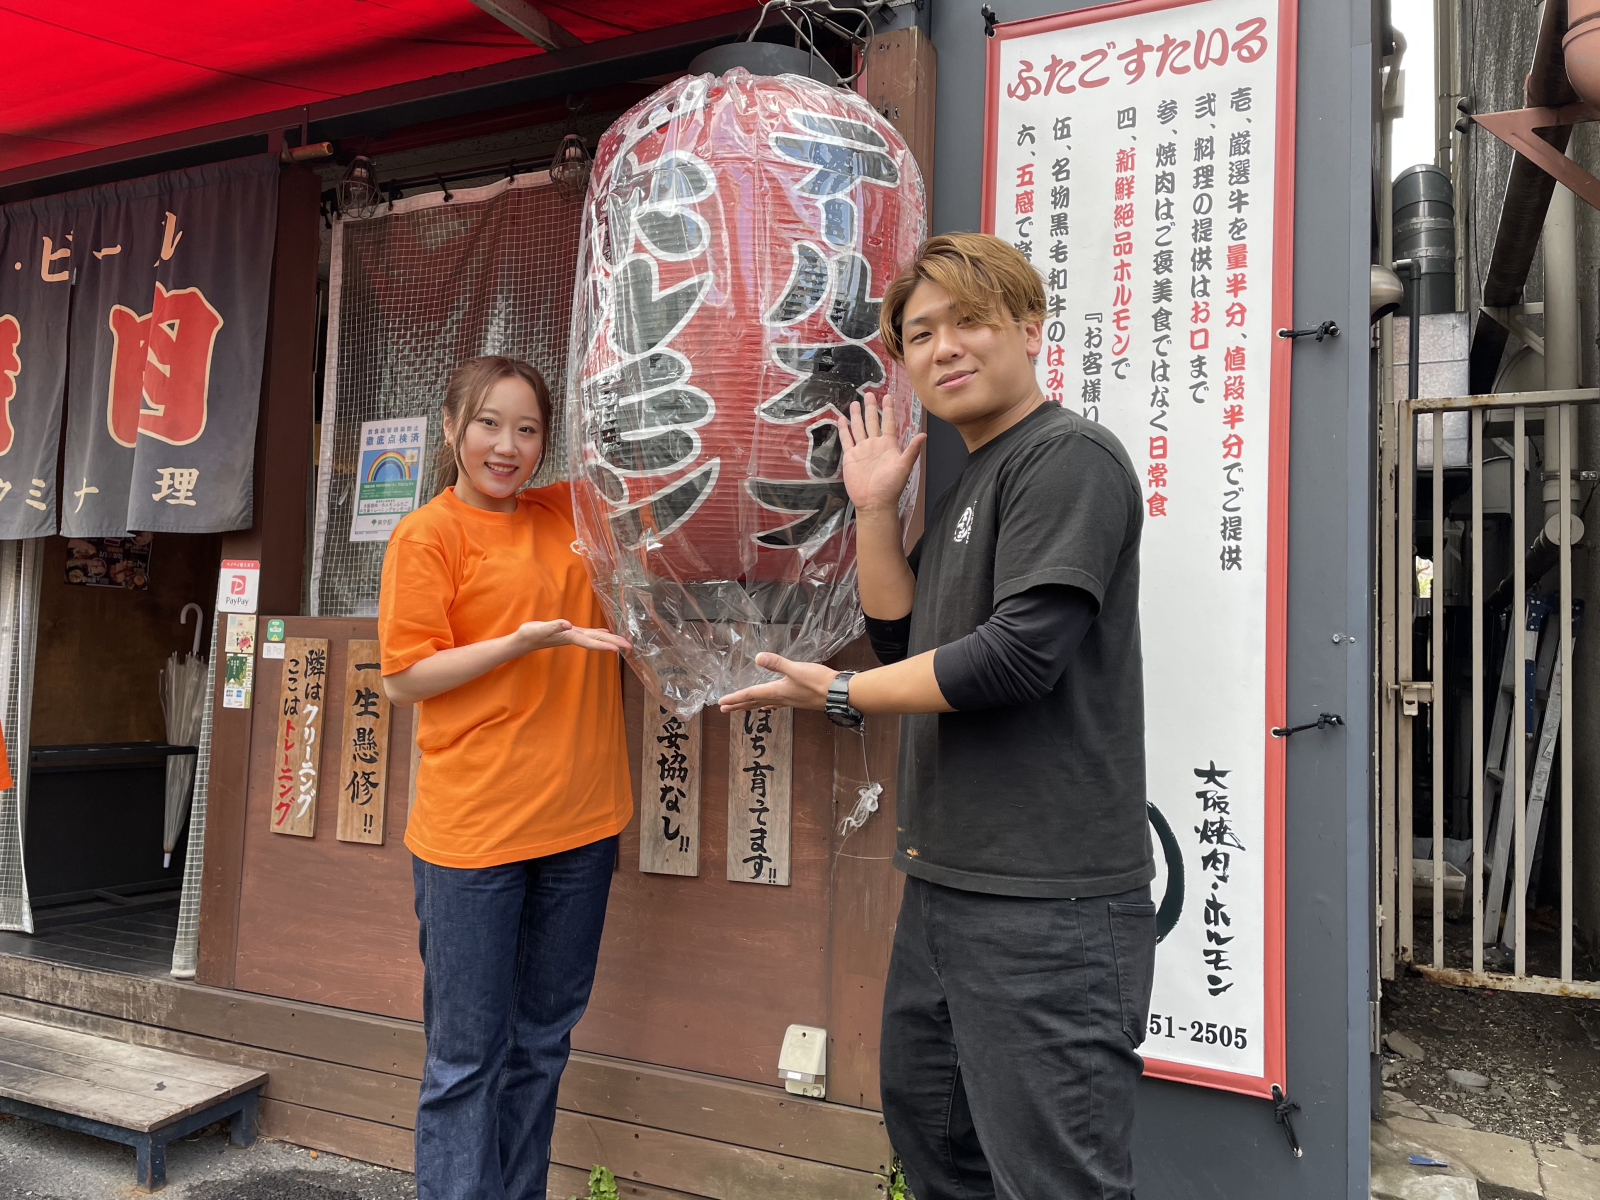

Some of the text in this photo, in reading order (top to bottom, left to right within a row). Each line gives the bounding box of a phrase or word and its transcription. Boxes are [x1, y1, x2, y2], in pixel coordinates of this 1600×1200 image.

[1007, 17, 1268, 102] ふたごすたいる
[1110, 106, 1137, 380] 四、新鮮絶品ホルモンで
[1146, 99, 1178, 517] 参、焼肉はご褒美食ではなく日常食
[1188, 92, 1217, 404] 弐、料理の提供はお口まで
[1220, 87, 1253, 571] 壱、厳選牛を量半分、値段半分でご提供
[365, 432, 420, 446] 徹底点検済
[225, 597, 249, 606] PayPay
[275, 658, 301, 826] ここはトレーニング
[296, 648, 326, 818] 隣はクリーニング
[656, 704, 690, 853] 妥協なし!!
[1193, 759, 1247, 997] 大阪焼肉・ホルモン
[1146, 1013, 1248, 1050] 51-2505
